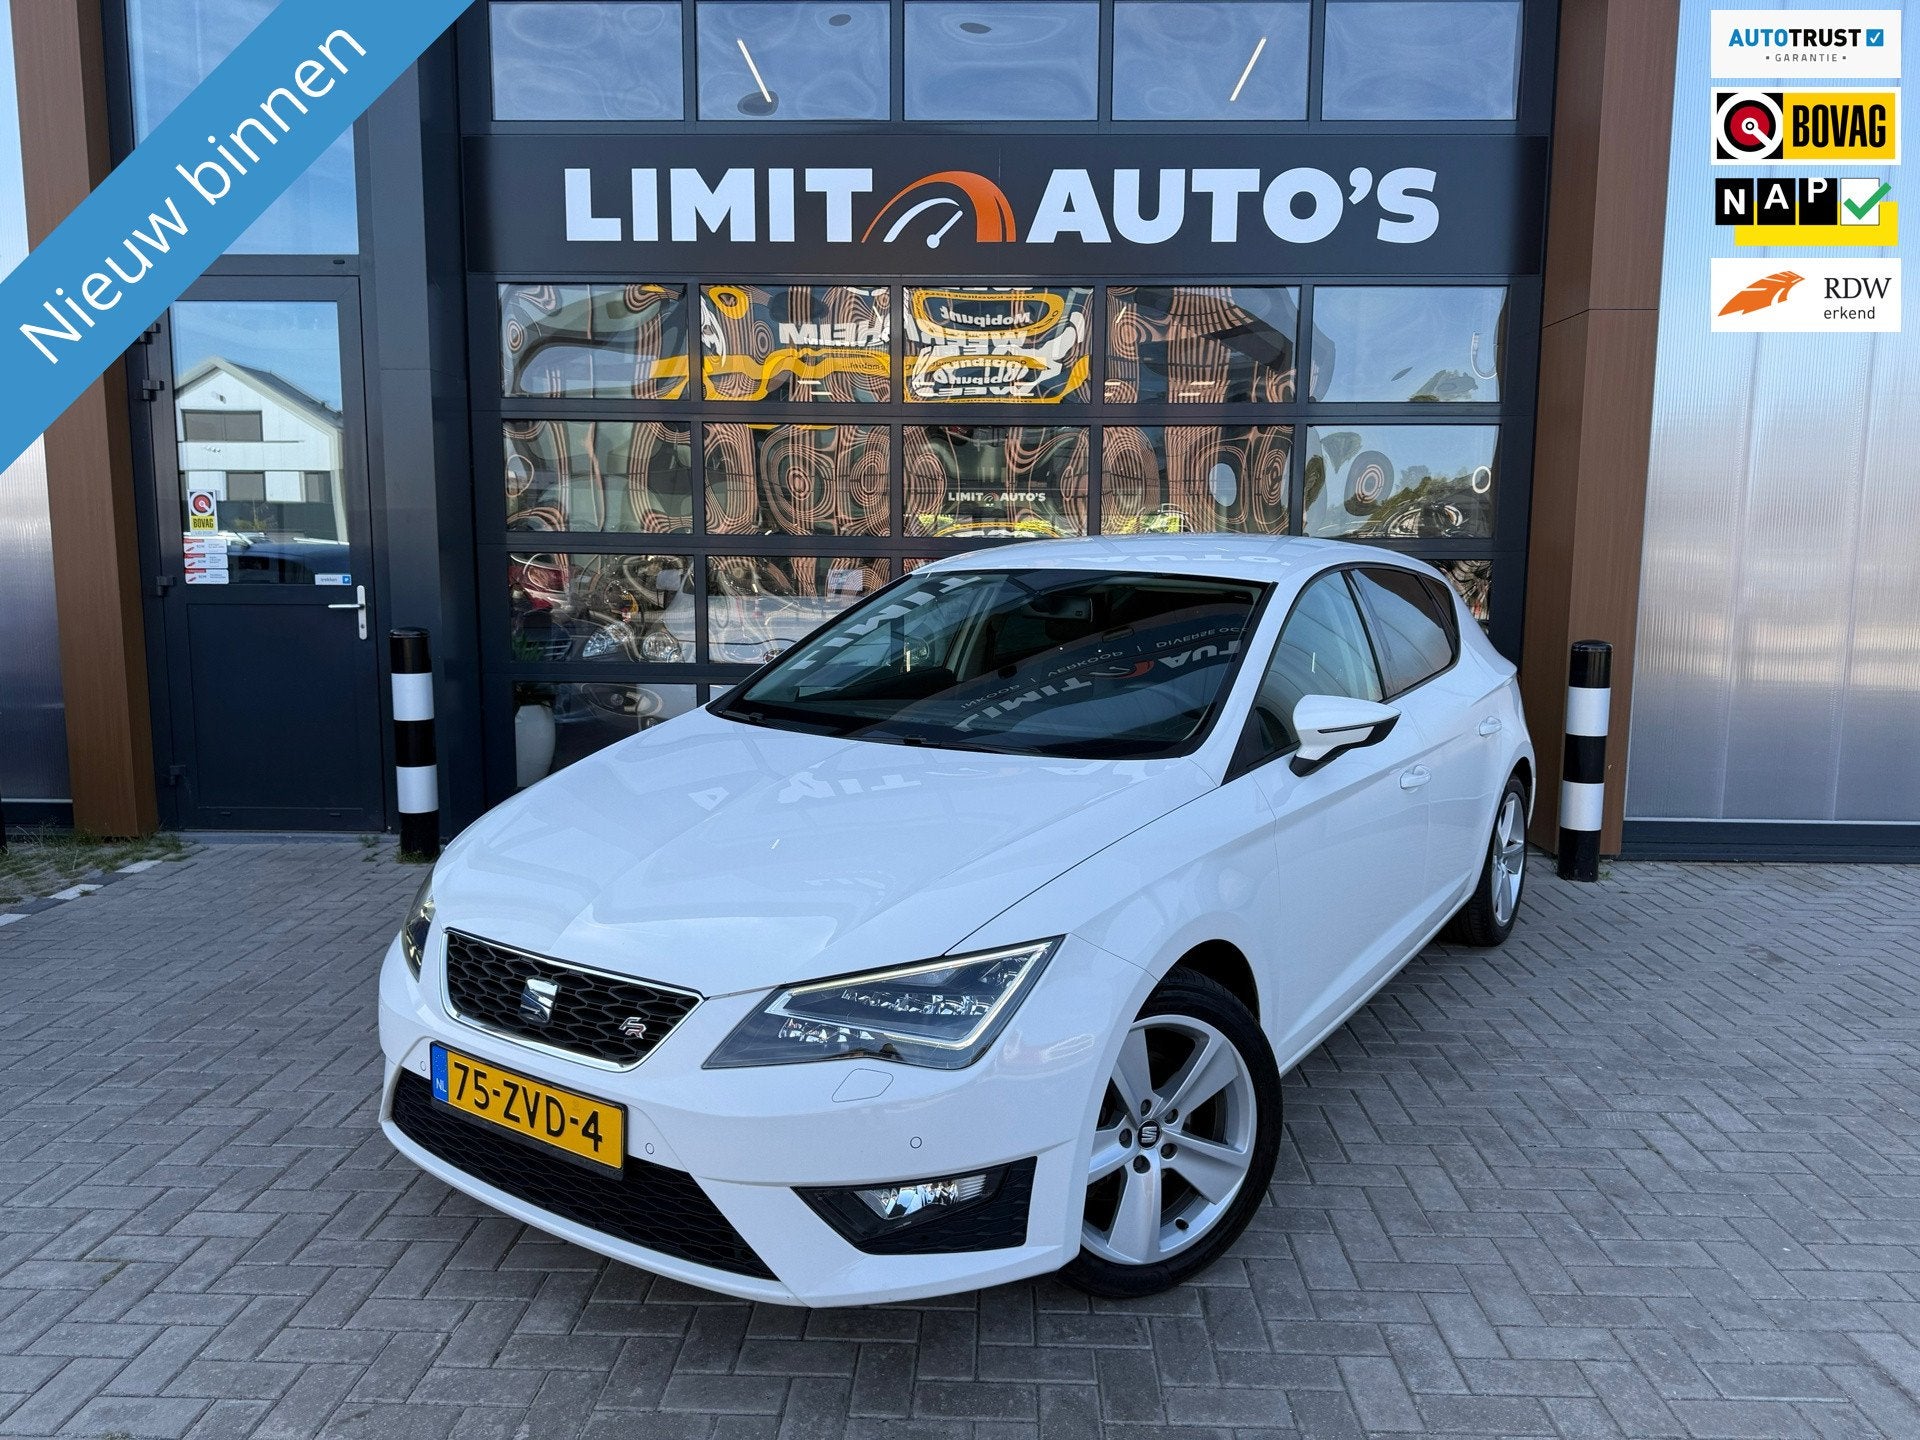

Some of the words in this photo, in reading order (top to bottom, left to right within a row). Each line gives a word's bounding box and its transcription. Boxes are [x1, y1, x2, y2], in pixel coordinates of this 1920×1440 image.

[565, 168, 873, 243] LIMIT
[1026, 167, 1441, 245] AUTO'S
[948, 492, 983, 502] LIMIT
[193, 518, 214, 529] BOVAG
[435, 1077, 447, 1093] NL
[454, 1061, 603, 1152] 75-ZVD-4
